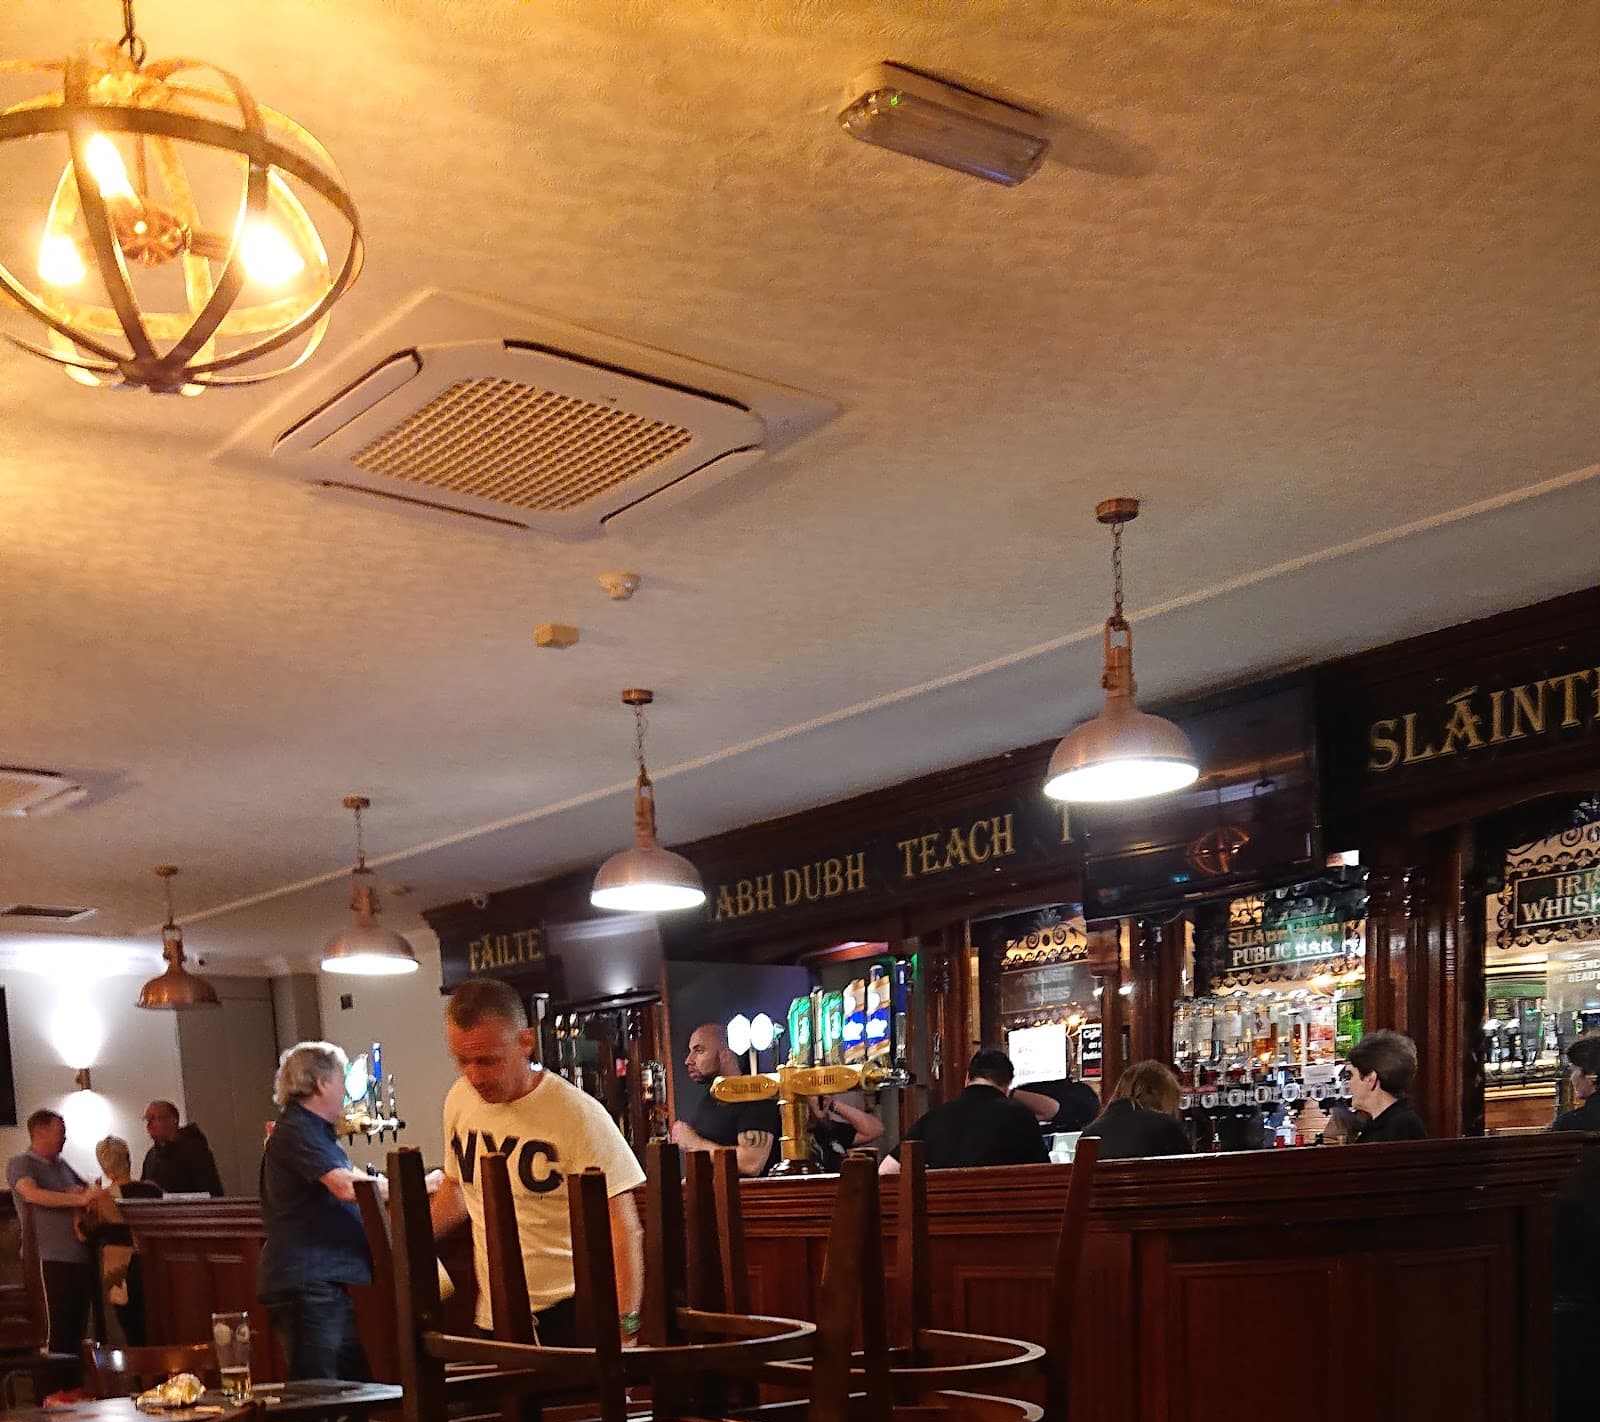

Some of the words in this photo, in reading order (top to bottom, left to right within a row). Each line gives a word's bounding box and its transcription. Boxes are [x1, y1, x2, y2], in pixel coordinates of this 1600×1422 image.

[897, 813, 1016, 879] TEACH
[715, 874, 777, 921] ABH
[784, 852, 868, 905] DUBH
[469, 929, 543, 972] FÁILTE
[1232, 941, 1292, 966] PUBLIC
